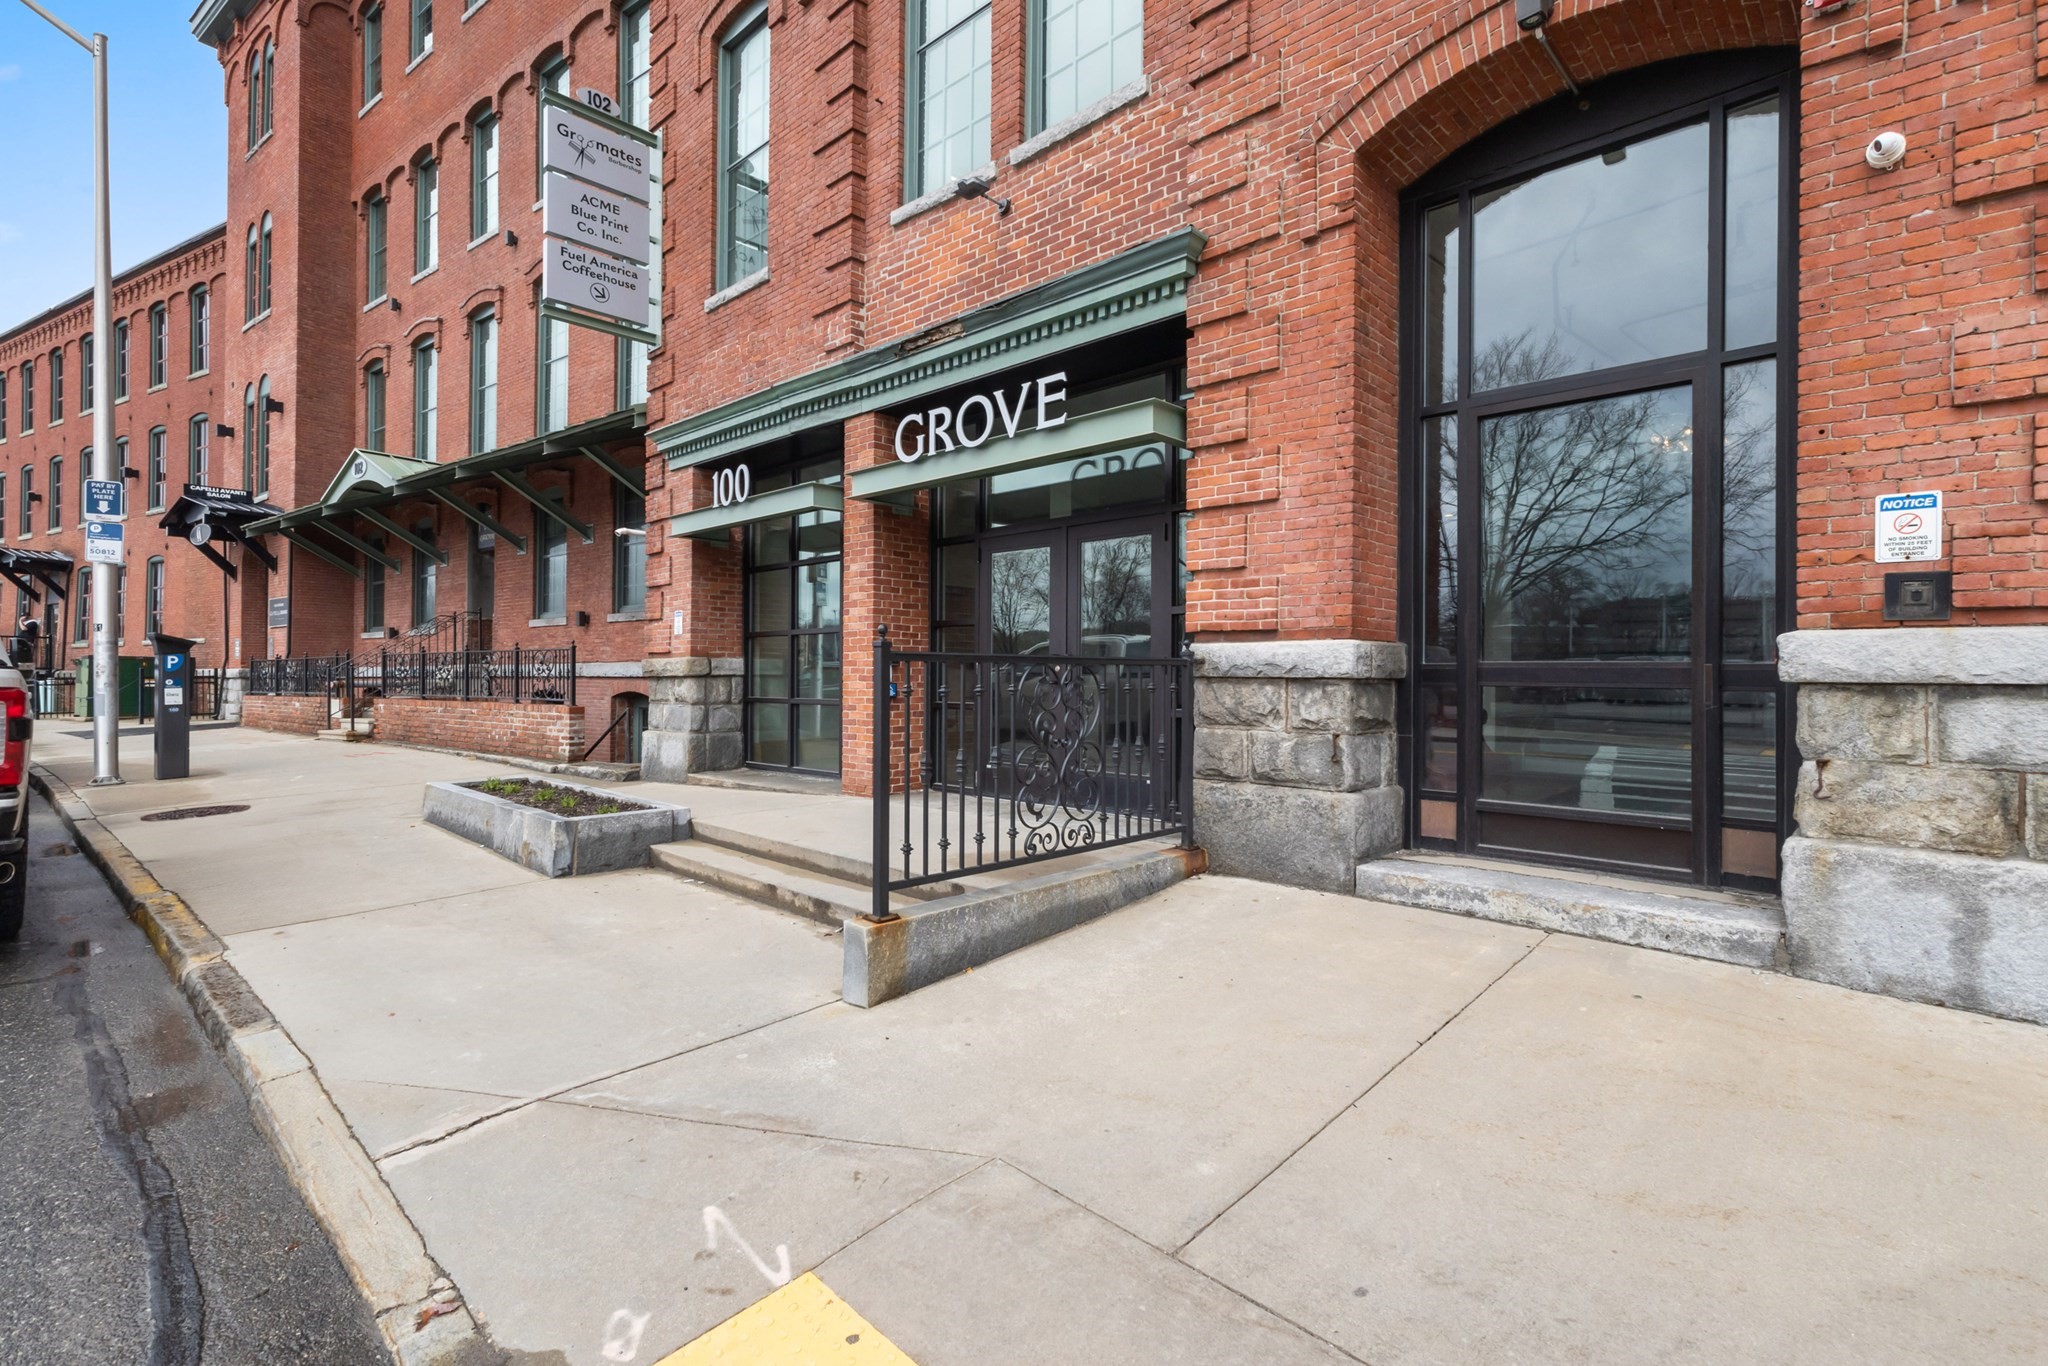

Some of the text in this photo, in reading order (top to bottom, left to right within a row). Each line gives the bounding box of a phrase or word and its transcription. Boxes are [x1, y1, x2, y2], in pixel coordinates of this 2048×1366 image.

[587, 90, 611, 113] 102
[608, 156, 642, 174] Barbershop
[581, 194, 620, 216] ACME
[571, 204, 629, 233] Blue Print
[577, 221, 622, 244] Co. Inc.
[560, 246, 638, 280] Fuel America
[562, 260, 636, 290] Coffeehouse
[895, 371, 1068, 463] GROVE
[190, 485, 219, 493] CAPELLI
[712, 463, 750, 508] 100
[1882, 497, 1935, 510] NOTICE
[89, 548, 116, 556] 50812
[167, 655, 179, 669] P
